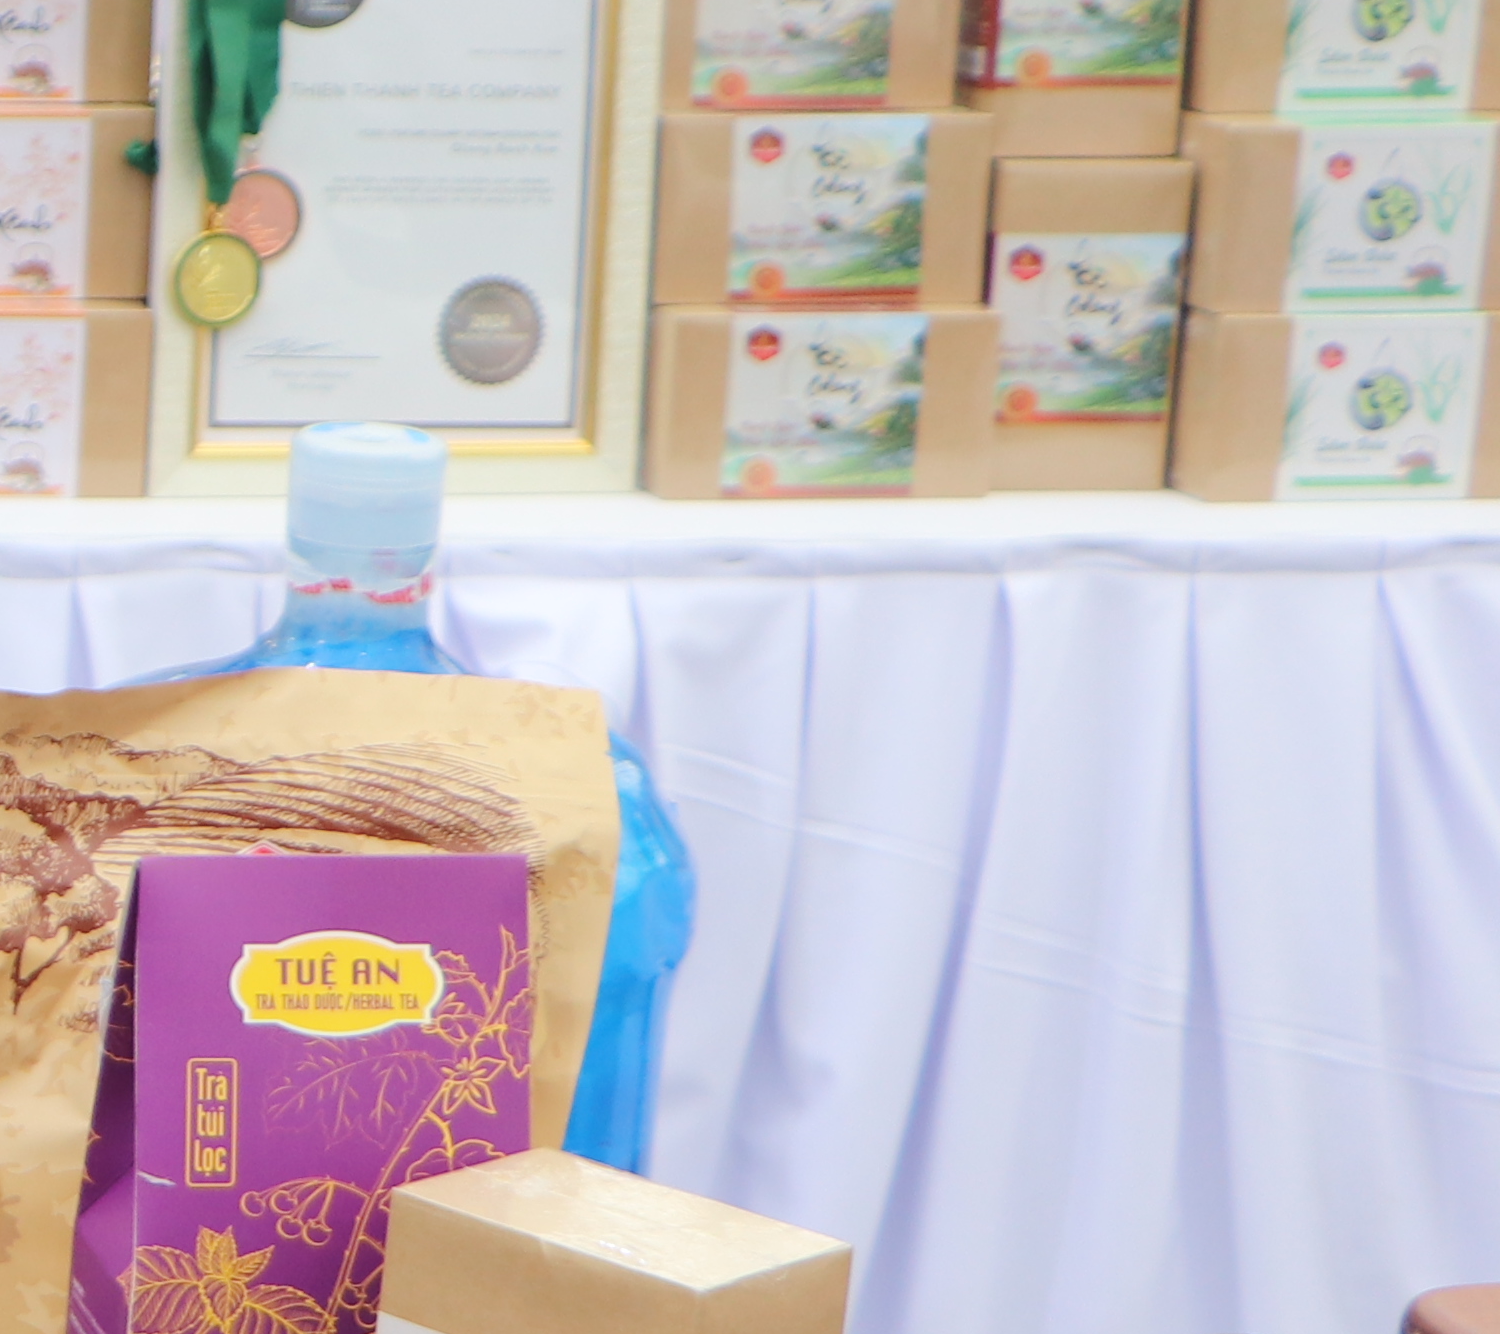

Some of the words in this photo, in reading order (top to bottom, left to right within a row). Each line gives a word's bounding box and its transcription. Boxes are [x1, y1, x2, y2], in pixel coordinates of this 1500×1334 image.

[275, 951, 337, 990] TUỆ
[352, 958, 401, 986] AN
[399, 992, 420, 1011] TEA
[195, 1068, 228, 1101] Trà
[197, 1103, 225, 1137] túi
[194, 1139, 227, 1177] lọc
